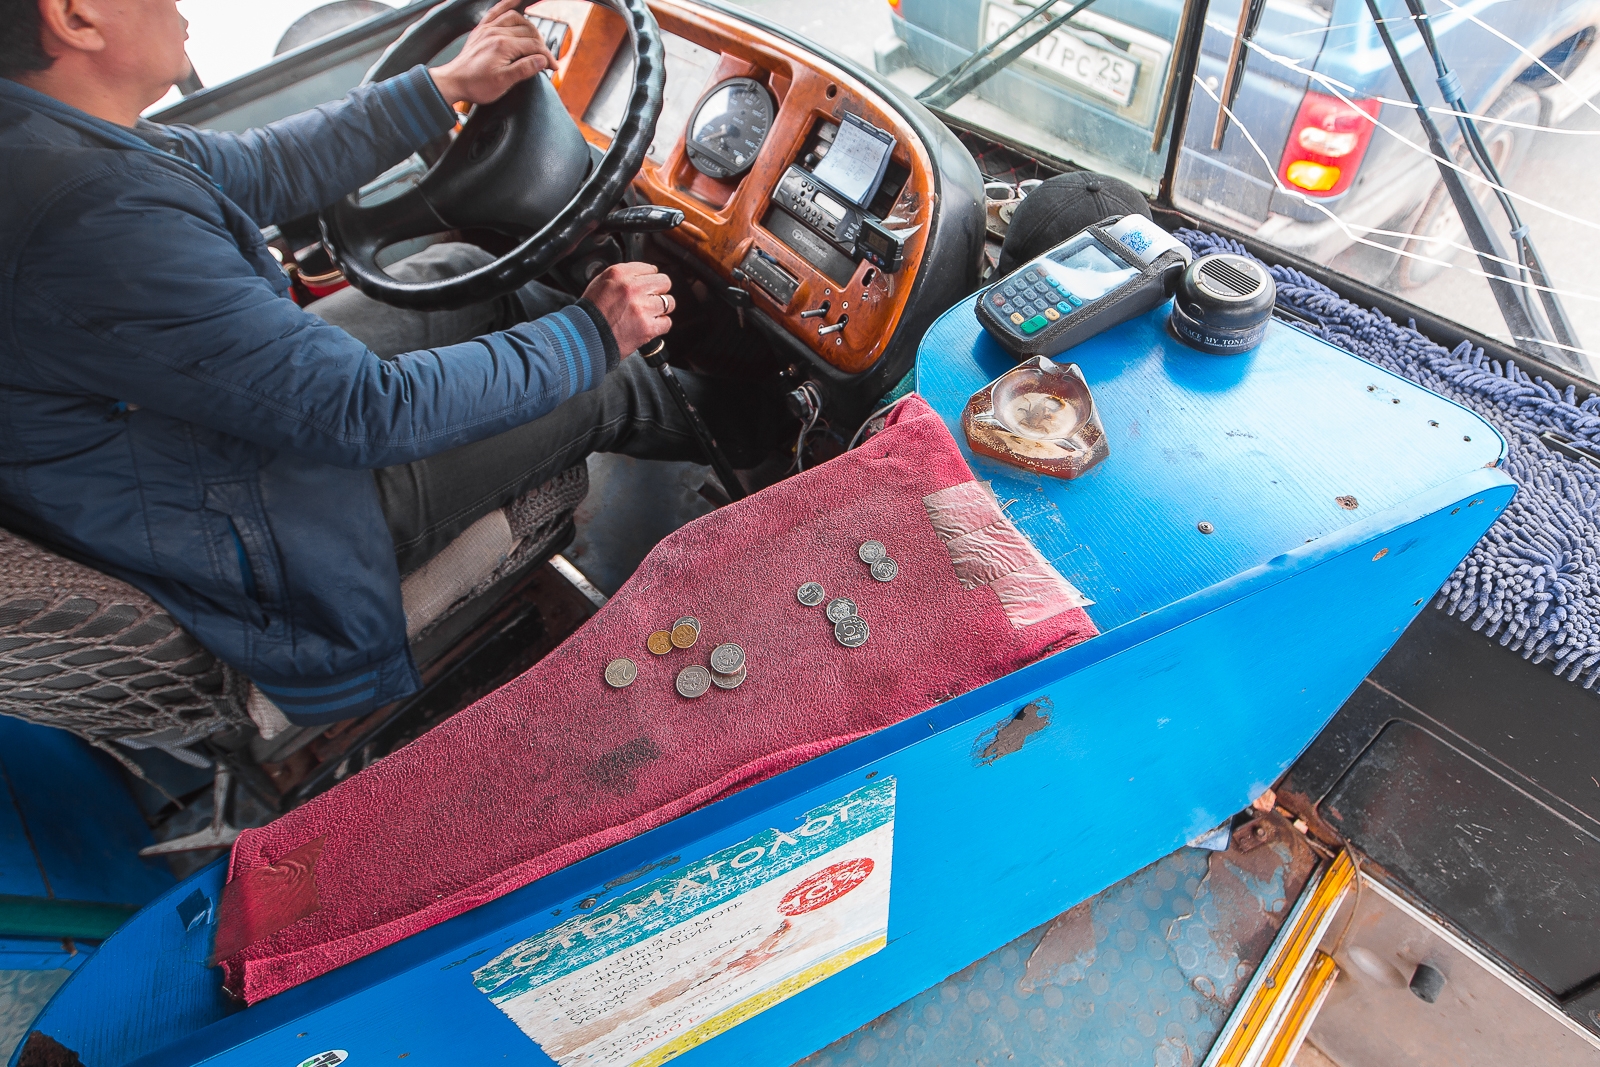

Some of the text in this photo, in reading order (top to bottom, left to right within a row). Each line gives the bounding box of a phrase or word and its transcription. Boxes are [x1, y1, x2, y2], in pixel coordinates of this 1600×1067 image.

[512, 799, 865, 967] СТОМАТОЛОГ
[548, 902, 743, 996] ПВИЧНЫЙ ОСМОТР
[571, 923, 714, 994] КНСУЛЬТАЦИЯ
[604, 979, 756, 1060] МЕТАЛОКАМИКА
[612, 1024, 653, 1047] ГОДА
[631, 1023, 682, 1052] 2900
